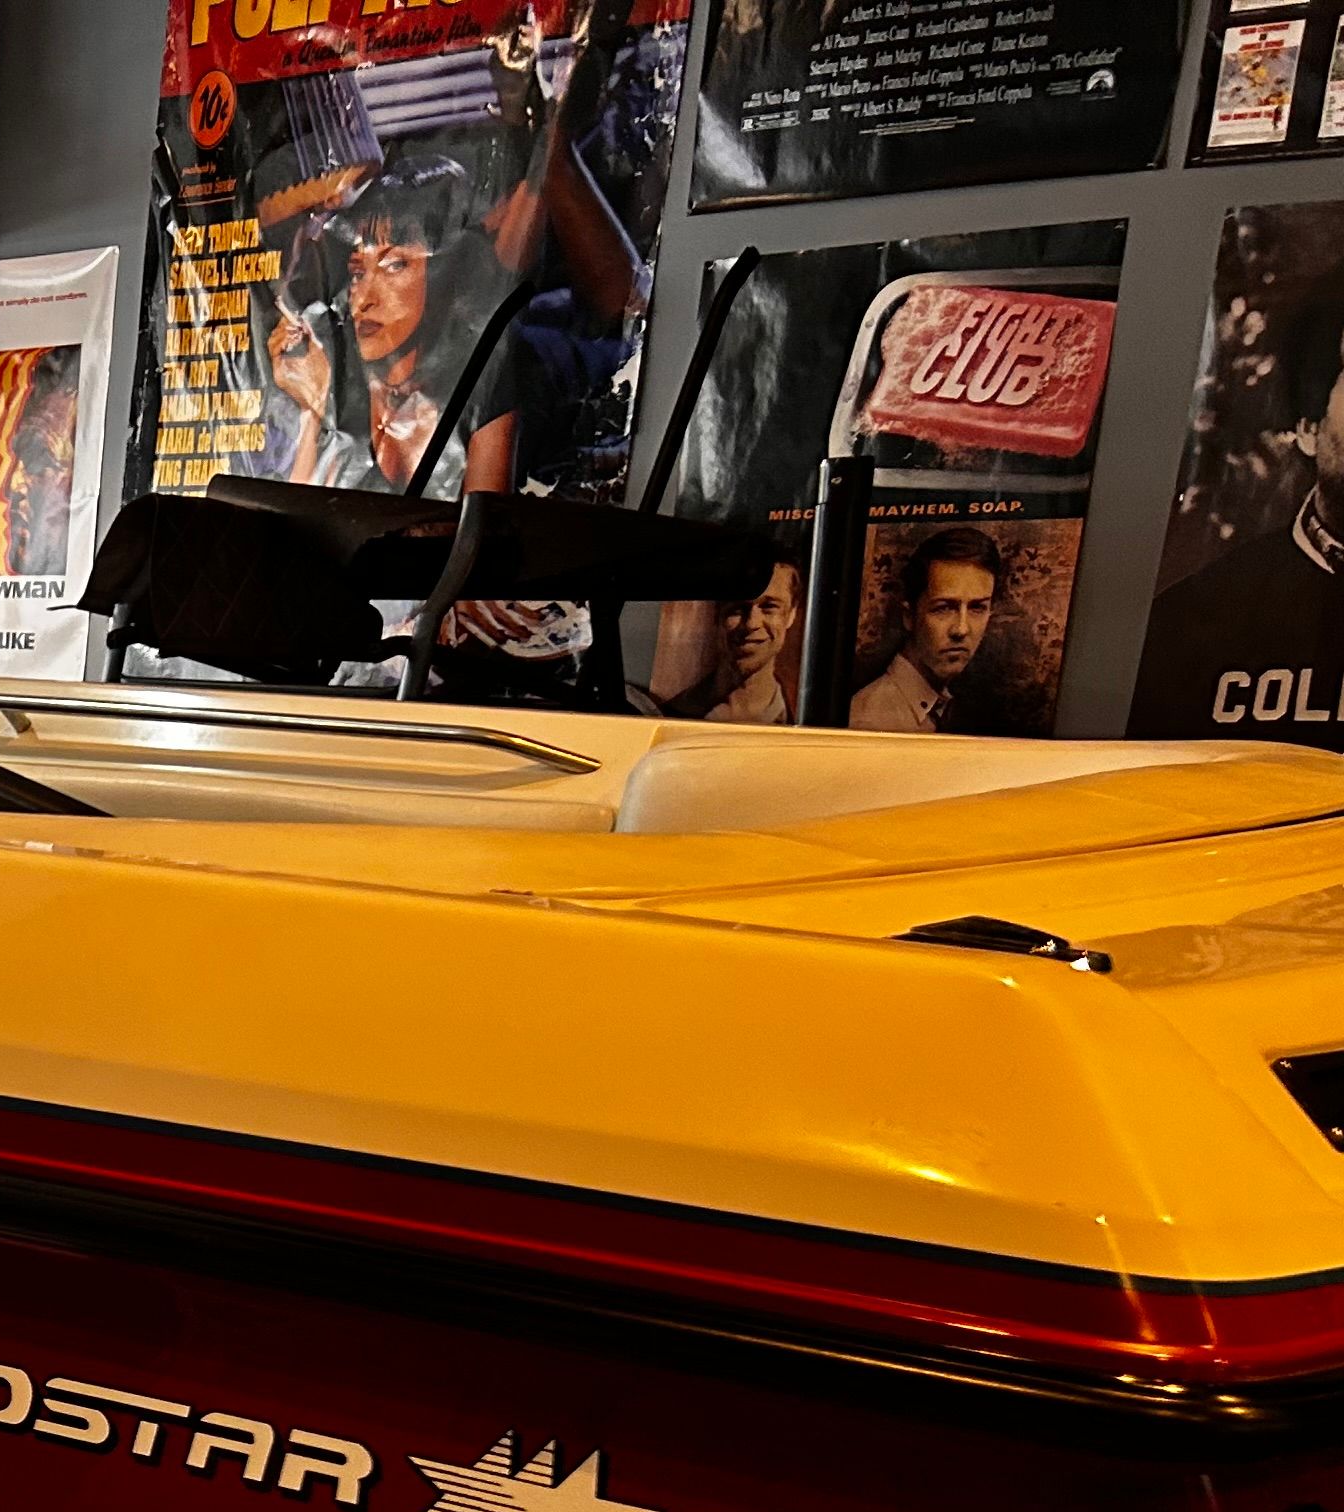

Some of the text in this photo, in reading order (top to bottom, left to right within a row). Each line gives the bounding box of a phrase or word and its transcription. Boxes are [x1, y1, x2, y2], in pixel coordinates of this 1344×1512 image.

[957, 299, 1078, 345] FIGHT
[910, 331, 1056, 406] CLUB
[155, 426, 195, 455] MARIA
[967, 499, 1025, 514] SOAP.
[1212, 667, 1344, 723] COL
